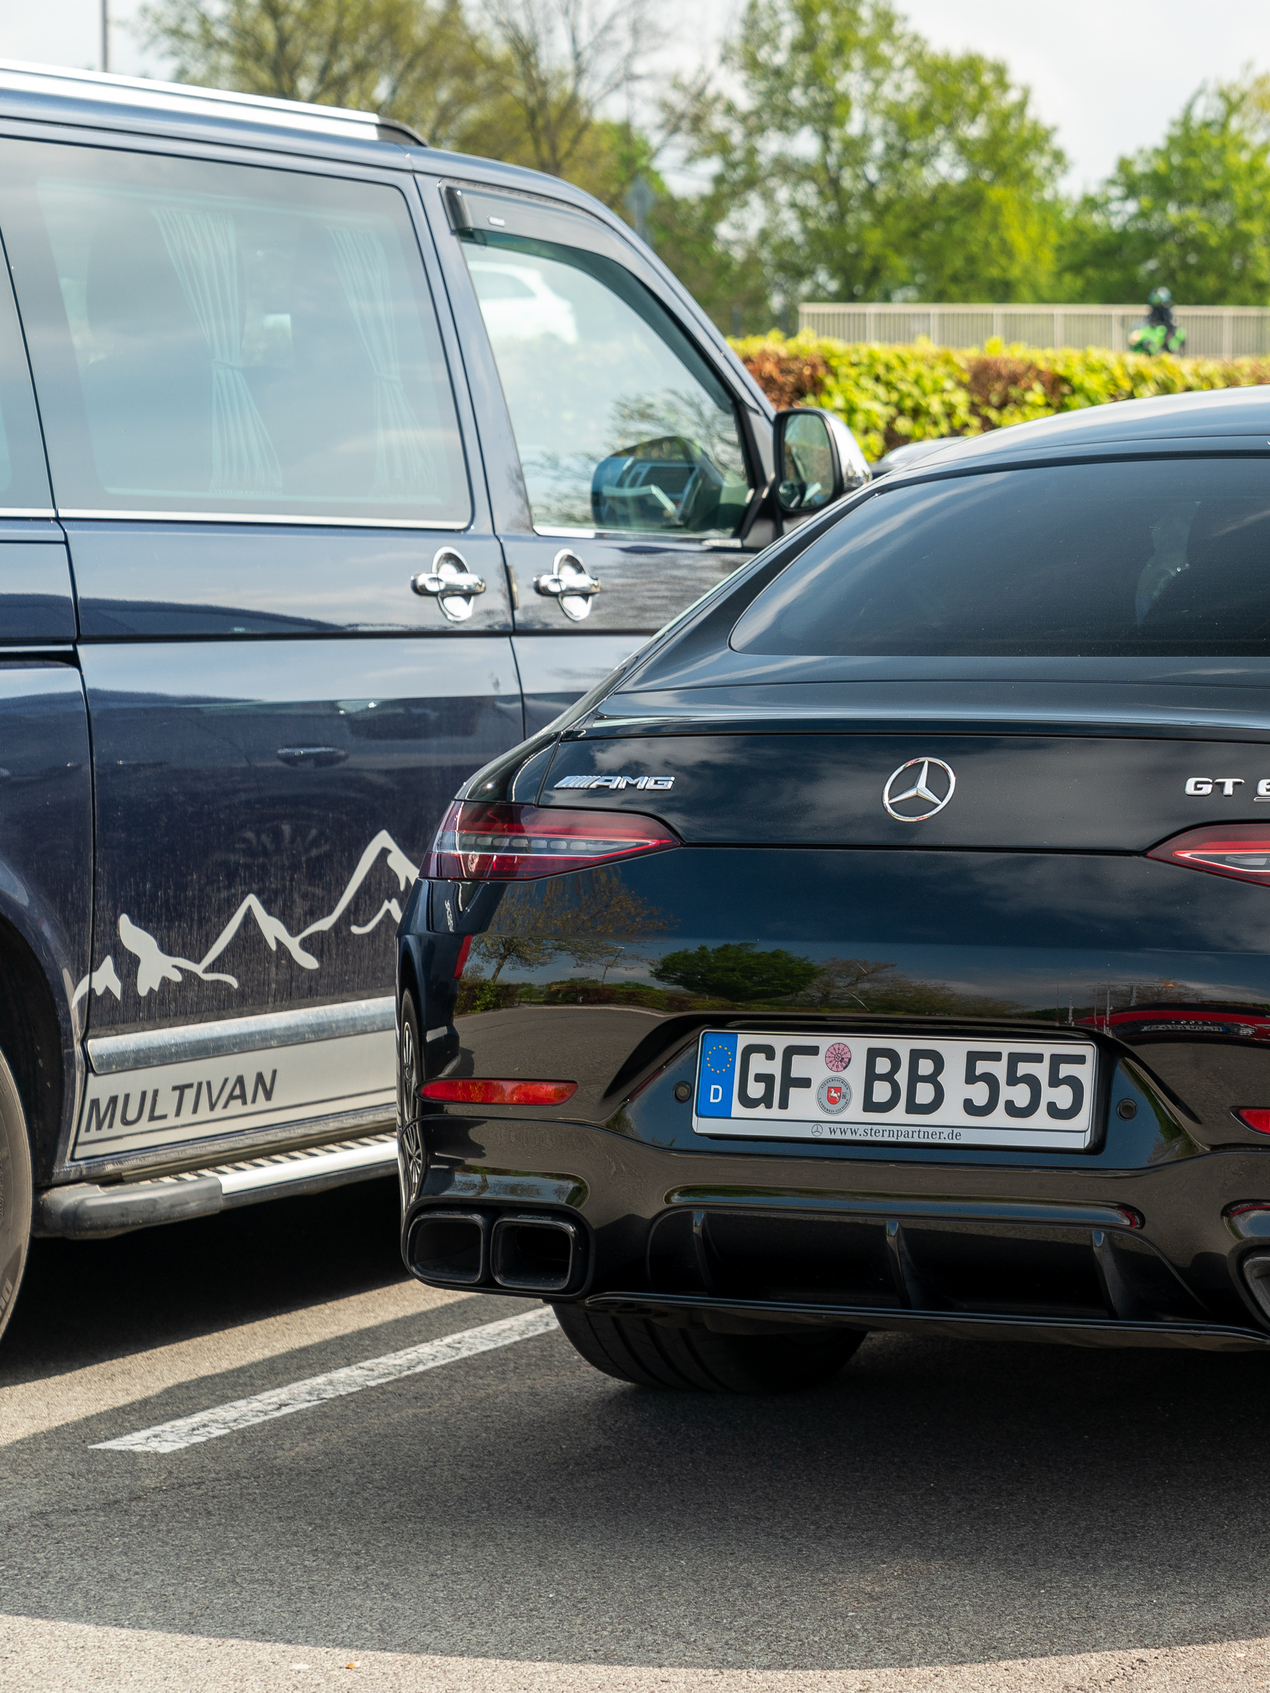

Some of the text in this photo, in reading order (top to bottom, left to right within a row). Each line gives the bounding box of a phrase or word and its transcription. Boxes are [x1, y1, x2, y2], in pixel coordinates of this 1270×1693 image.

[588, 776, 675, 790] AMG
[1185, 777, 1245, 796] GT
[737, 1043, 820, 1110] GF
[862, 1047, 945, 1115] BB
[963, 1050, 1086, 1121] 555
[84, 1068, 277, 1133] MULTIVAN
[709, 1085, 722, 1103] D
[828, 1125, 962, 1141] www.sternpartner.de
